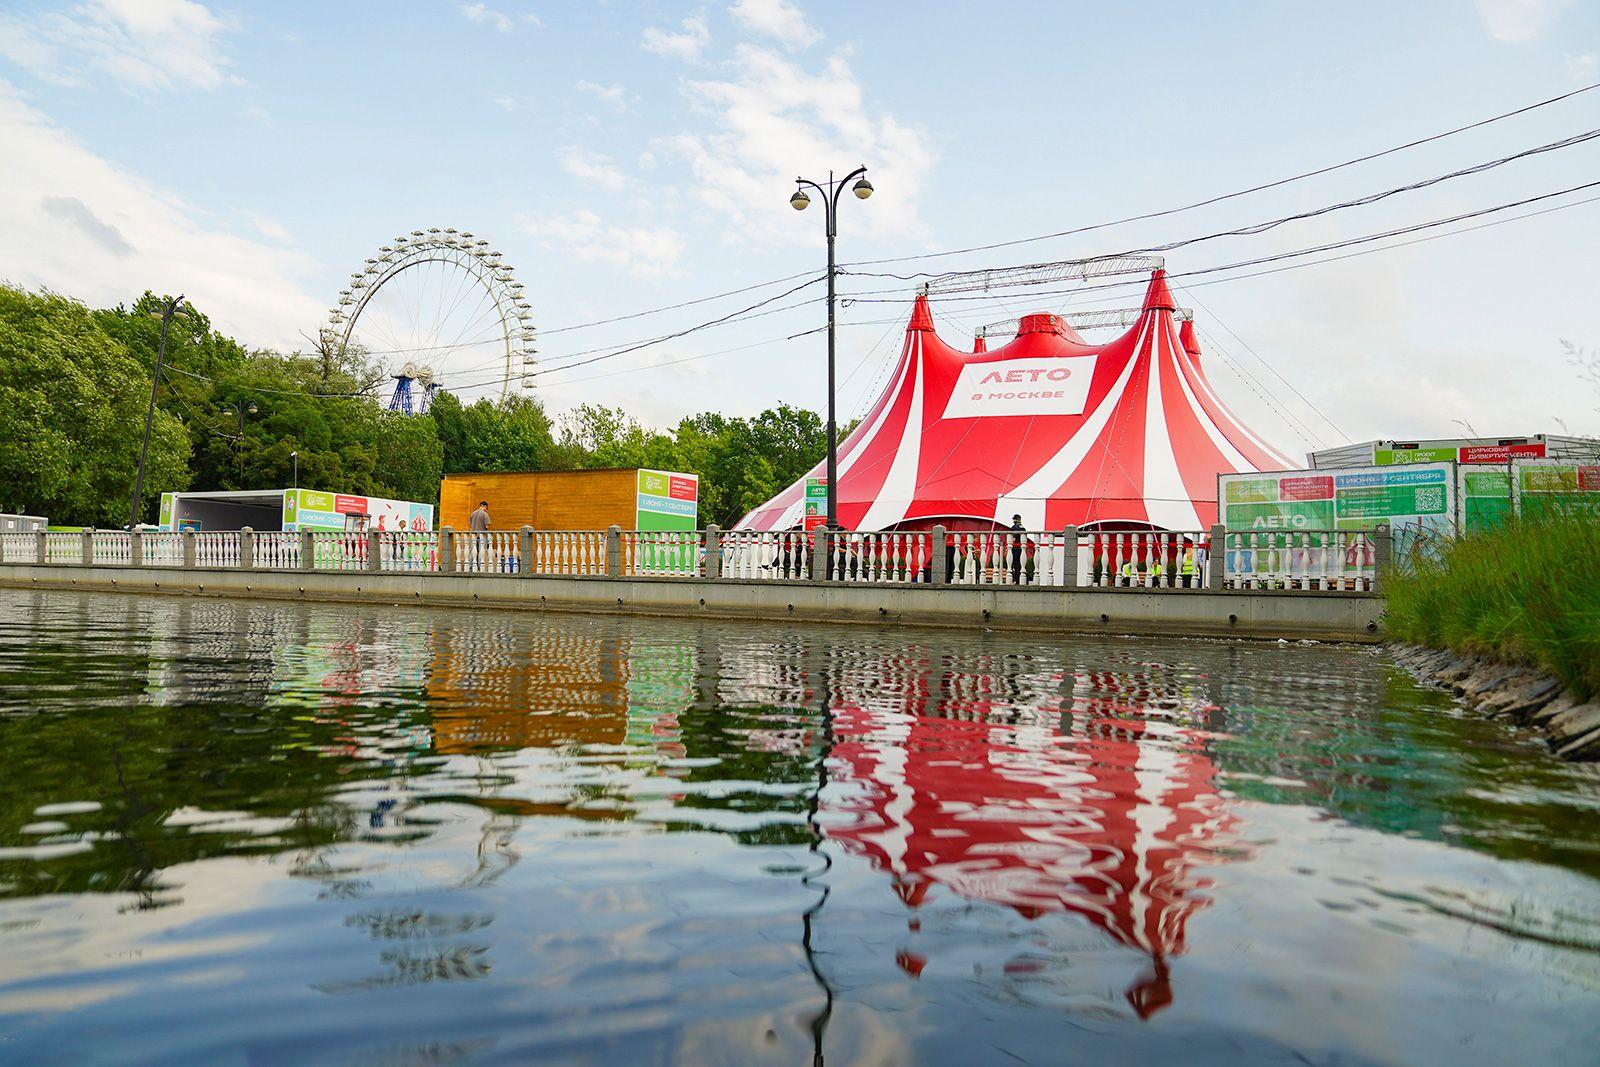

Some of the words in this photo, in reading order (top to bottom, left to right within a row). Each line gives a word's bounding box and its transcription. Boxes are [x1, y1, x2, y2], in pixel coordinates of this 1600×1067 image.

[980, 367, 1072, 384] ЛЕТО
[988, 390, 1065, 400] МОСКВЕ
[1467, 446, 1510, 454] ЦИРКОВЫЕ
[1346, 476, 1375, 484] ИЮНЯ
[1389, 473, 1441, 482] СЕНТЯБРЯ
[1252, 514, 1308, 528] ЛЕТО
